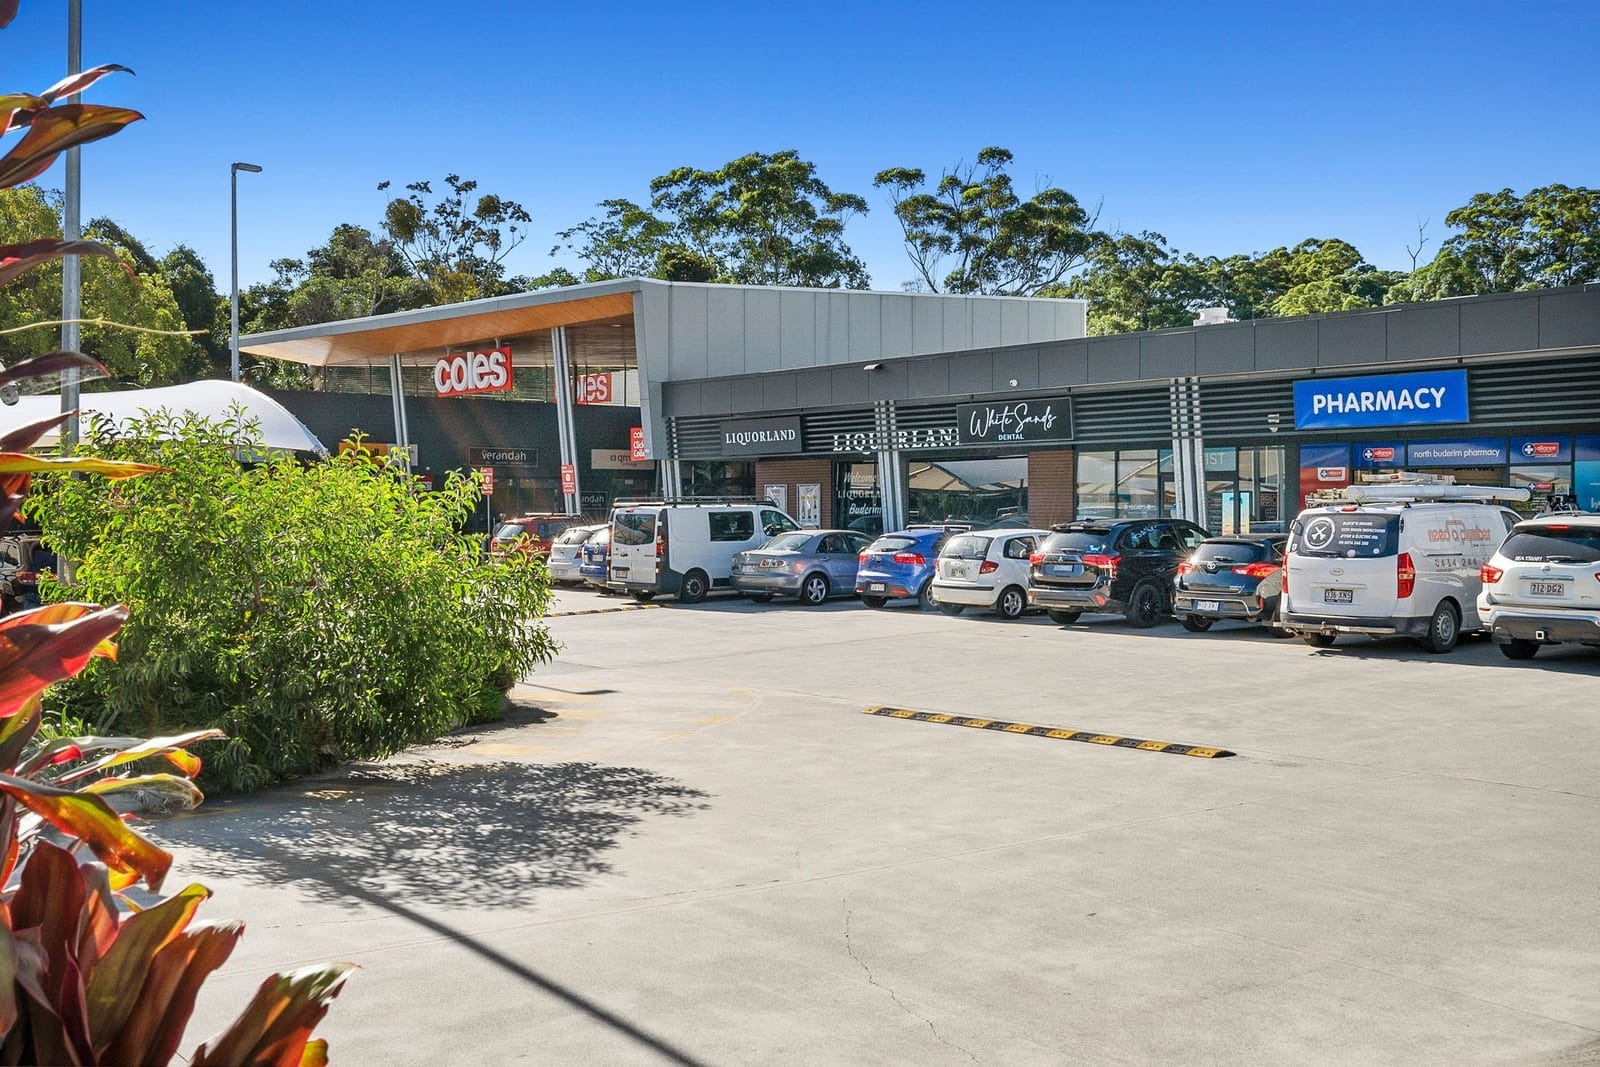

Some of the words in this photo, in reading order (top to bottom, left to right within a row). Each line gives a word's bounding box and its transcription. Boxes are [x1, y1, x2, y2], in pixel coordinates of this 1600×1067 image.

[434, 350, 508, 393] coles
[1313, 386, 1446, 415] PHARMACY
[969, 407, 1012, 438] White
[1011, 402, 1057, 435] Sands
[725, 429, 796, 446] LIQUORLAND
[998, 433, 1024, 441] DENTAL
[481, 450, 527, 461] verandah
[617, 454, 631, 464] qm
[1413, 449, 1432, 459] north
[1433, 447, 1462, 458] buderim
[1463, 447, 1500, 459] pharmacy
[844, 471, 876, 483] Welcome
[849, 503, 882, 515] Buderim
